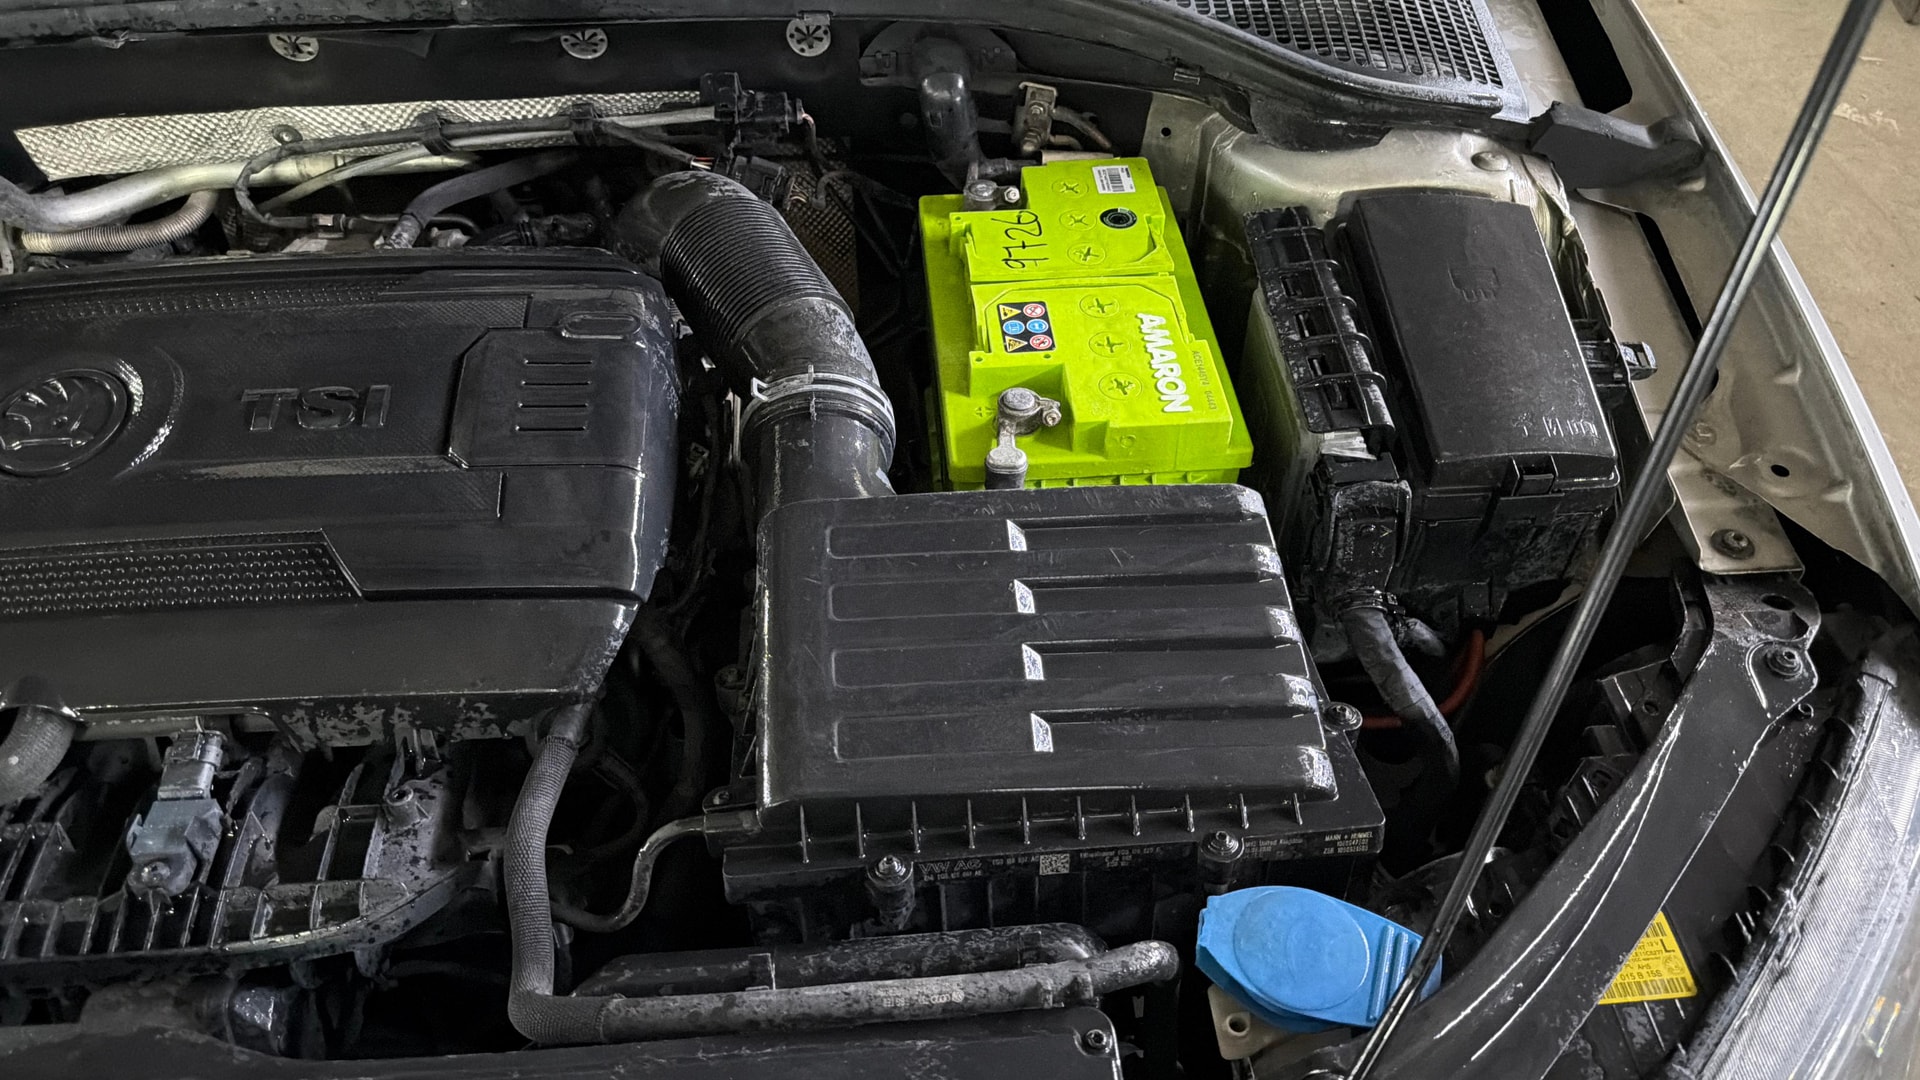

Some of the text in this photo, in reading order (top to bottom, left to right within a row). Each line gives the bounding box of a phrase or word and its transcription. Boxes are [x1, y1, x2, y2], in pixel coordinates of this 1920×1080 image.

[991, 210, 1049, 269] 9726
[1137, 312, 1193, 412] AMARON
[241, 384, 391, 432] TSI
[1324, 834, 1342, 842] MANN
[1350, 831, 1373, 839] HUMMEL
[919, 860, 950, 874] VW
[954, 858, 983, 871] AG
[1660, 939, 1675, 953] L
